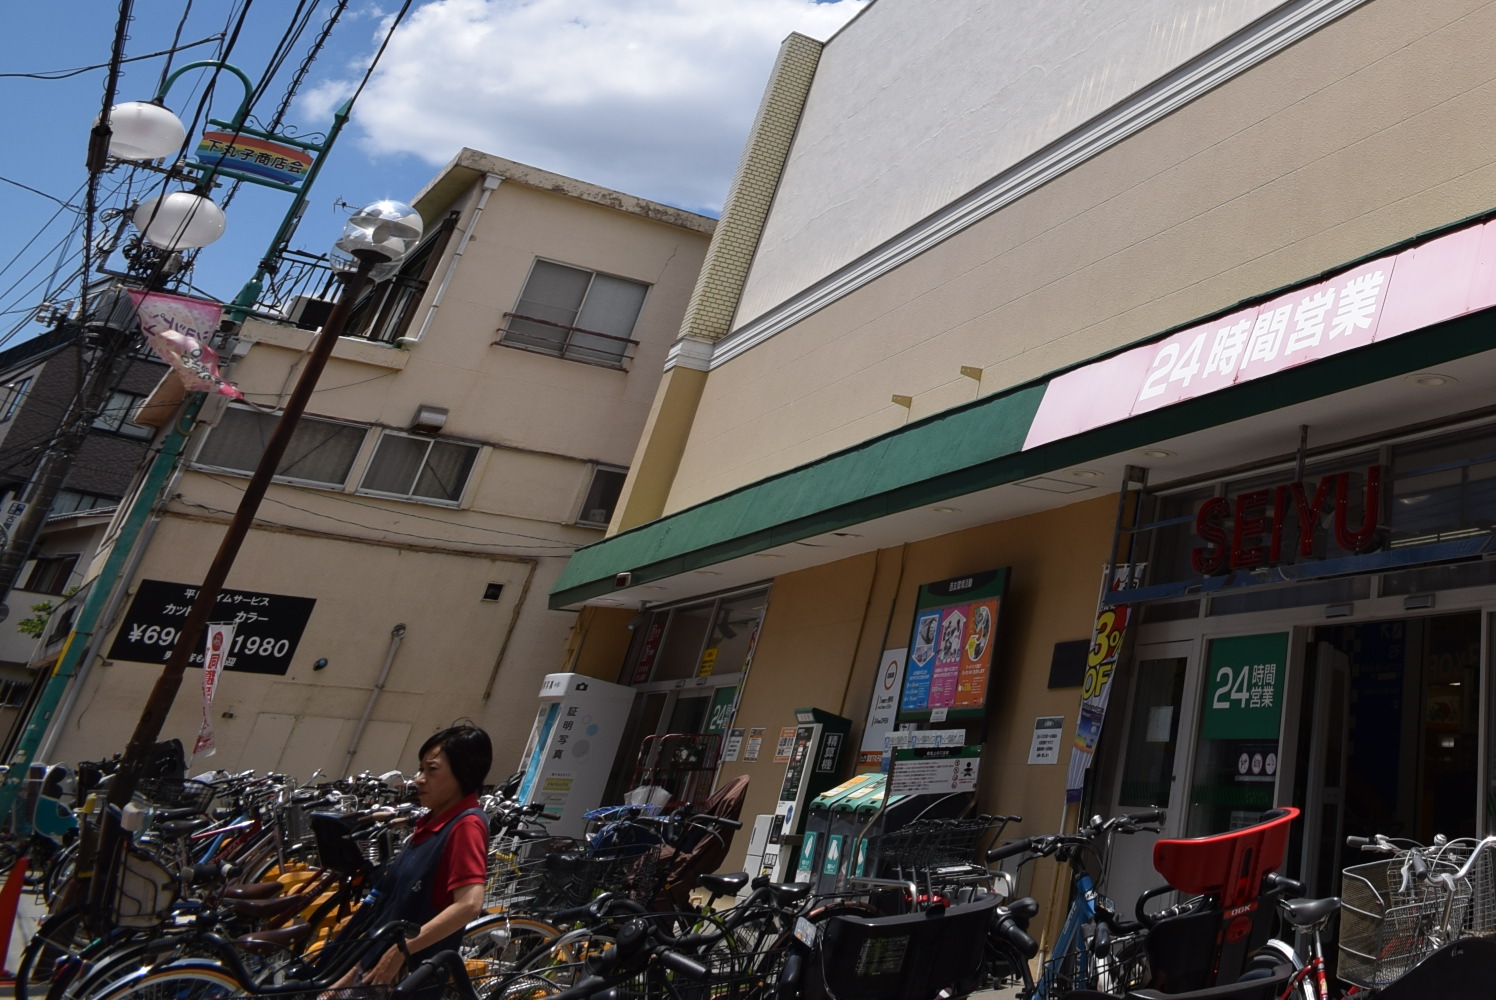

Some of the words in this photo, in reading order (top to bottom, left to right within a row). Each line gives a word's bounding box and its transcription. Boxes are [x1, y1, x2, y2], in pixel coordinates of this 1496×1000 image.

[208, 139, 304, 174] 下丸子商店会
[1138, 270, 1385, 402] 24時間営業
[1191, 465, 1381, 576] SEIYU
[184, 588, 270, 606] 平イムサービス
[234, 611, 269, 623] カラー
[233, 634, 289, 658] 1980
[1082, 663, 1114, 700] OF
[1213, 666, 1249, 709] 24
[1251, 663, 1277, 685] 時間
[1250, 686, 1275, 708] 営業
[552, 707, 579, 759] 証明写真
[710, 704, 727, 729] 24
[821, 734, 839, 770] 精算機
